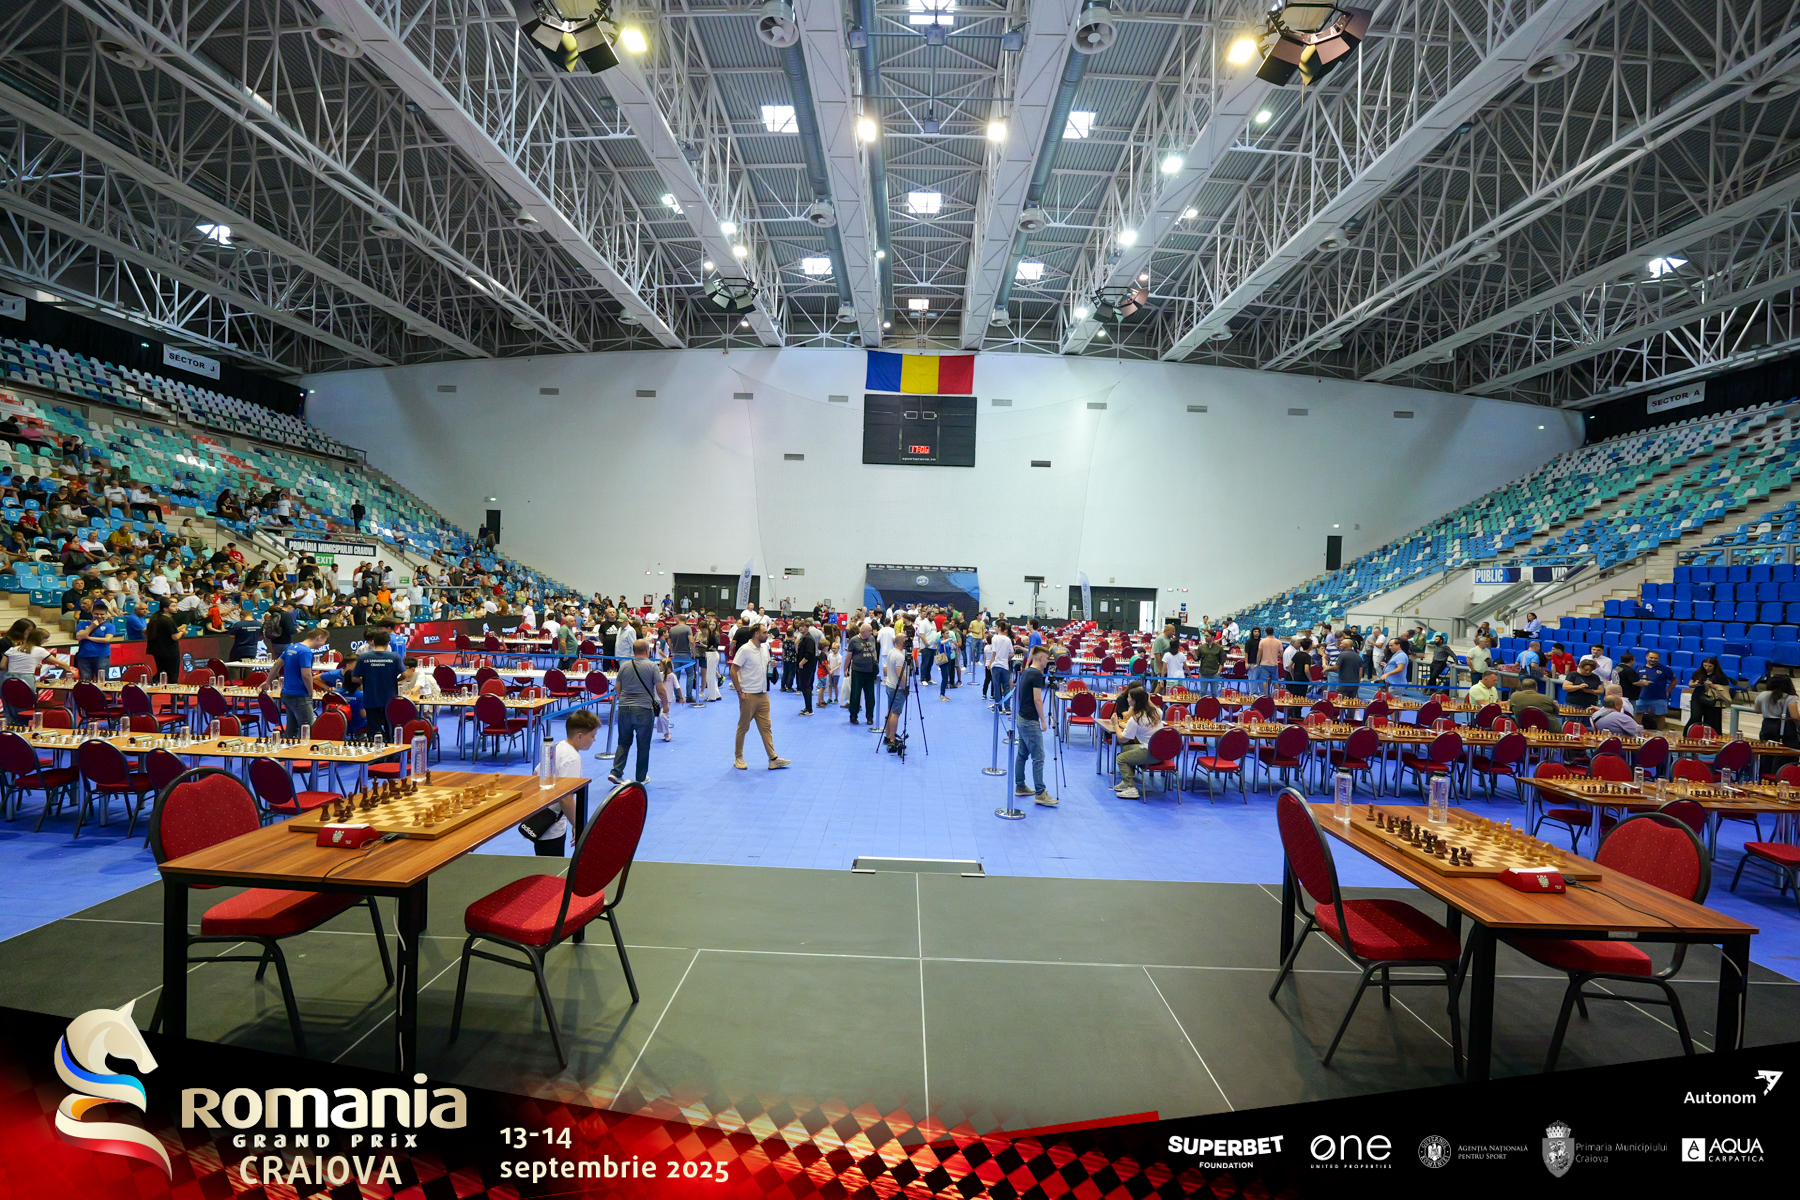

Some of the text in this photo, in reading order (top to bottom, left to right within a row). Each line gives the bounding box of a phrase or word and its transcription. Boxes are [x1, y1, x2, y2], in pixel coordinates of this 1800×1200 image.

[169, 353, 204, 369] SECTOR
[1652, 393, 1688, 406] SECTOR
[911, 446, 929, 454] 17:06
[289, 541, 374, 556] PRIMĂRIA MUNICIPIULUI CRAIOVA
[315, 556, 333, 565] EXIT
[1476, 569, 1503, 582] PUBLIC
[1552, 567, 1568, 582] VIP
[521, 823, 537, 838] adidas
